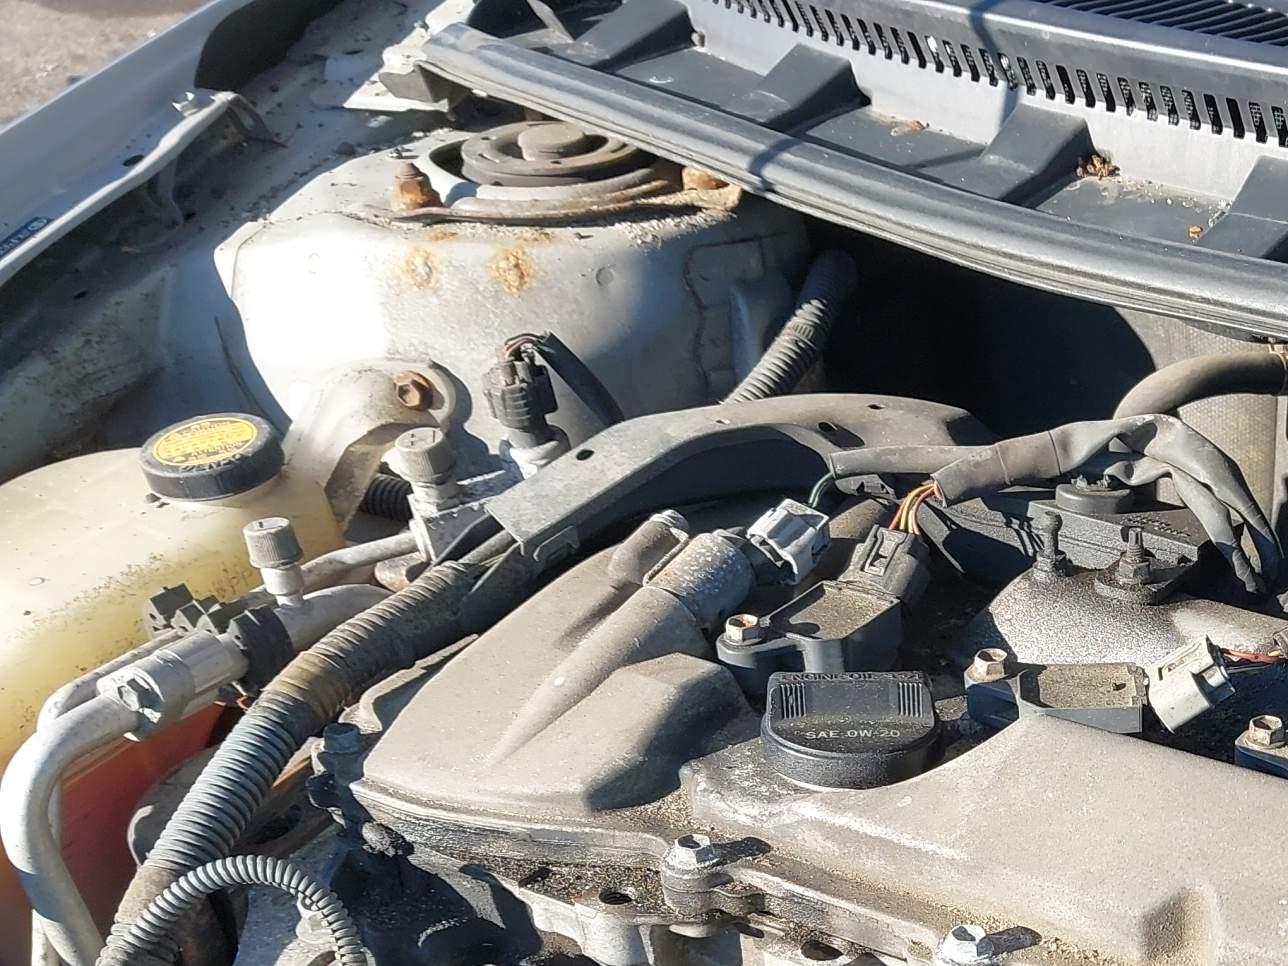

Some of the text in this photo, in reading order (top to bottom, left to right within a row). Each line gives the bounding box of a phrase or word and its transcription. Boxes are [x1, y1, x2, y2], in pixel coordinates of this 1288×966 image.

[849, 672, 878, 681] OIL
[805, 729, 901, 739] SAE 0W-20
